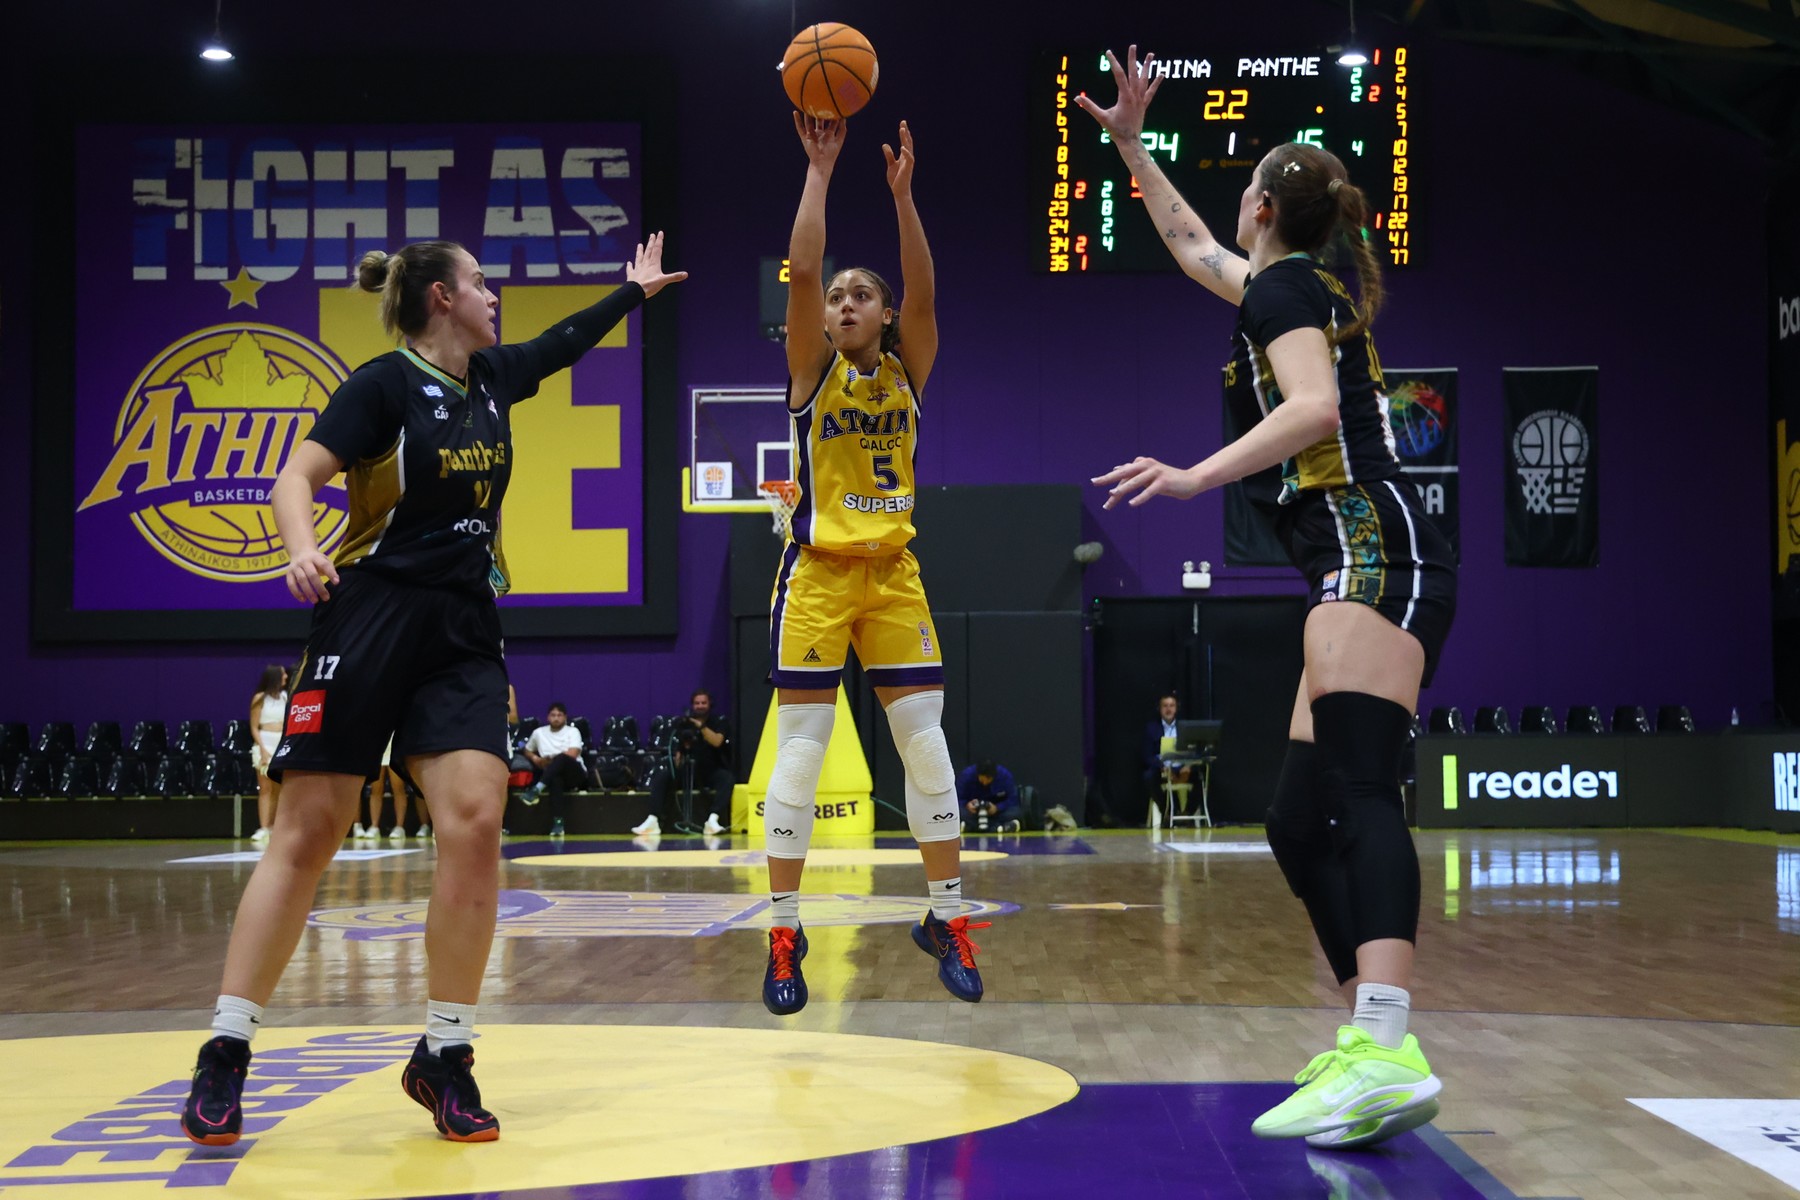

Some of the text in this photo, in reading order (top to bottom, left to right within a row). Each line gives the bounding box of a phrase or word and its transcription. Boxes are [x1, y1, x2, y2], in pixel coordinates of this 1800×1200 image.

[1061, 55, 1068, 71] 1
[1373, 48, 1381, 66] 1
[1237, 57, 1320, 77] PANTHE
[1350, 65, 1407, 85] 2 2
[1056, 73, 1068, 90] 4
[1056, 91, 1068, 109] 5
[1350, 84, 1407, 103] 2 2 4
[1203, 89, 1248, 121] 2.2
[1396, 102, 1407, 120] 5
[1056, 110, 1068, 127] 6
[1057, 127, 1069, 144] 7
[1397, 120, 1408, 138] 7
[1228, 131, 1236, 156] 1
[1351, 138, 1408, 157] 4 10
[1056, 145, 1069, 163] 8
[1057, 163, 1069, 181] 9
[1392, 157, 1408, 175] 12
[1053, 181, 1069, 200] 13
[1074, 180, 1087, 199] 2
[1101, 180, 1114, 199] 2
[1393, 175, 1408, 193] 13
[132, 136, 631, 282] FIGHT AS
[1048, 198, 1113, 218] 23 8
[1393, 193, 1409, 211] 17
[1048, 216, 1114, 236] 24 2
[1375, 211, 1409, 230] 1 22
[1049, 235, 1114, 254] 34 2 4
[1388, 230, 1409, 247] 41
[1049, 253, 1088, 272] 35 1
[1390, 248, 1409, 266] 77
[1778, 296, 1800, 341] ba
[819, 407, 911, 442] ATHIN
[76, 386, 347, 513] ATHI
[871, 454, 900, 492] 5
[193, 488, 274, 503] BASKETBA
[843, 492, 915, 514] SUPERB
[161, 529, 273, 569] ATHINAIKOS 1917
[313, 655, 341, 680] 17
[290, 703, 322, 715] Coral
[1468, 764, 1618, 799] reader
[1773, 751, 1800, 812] RE
[755, 800, 859, 820] SRBET
